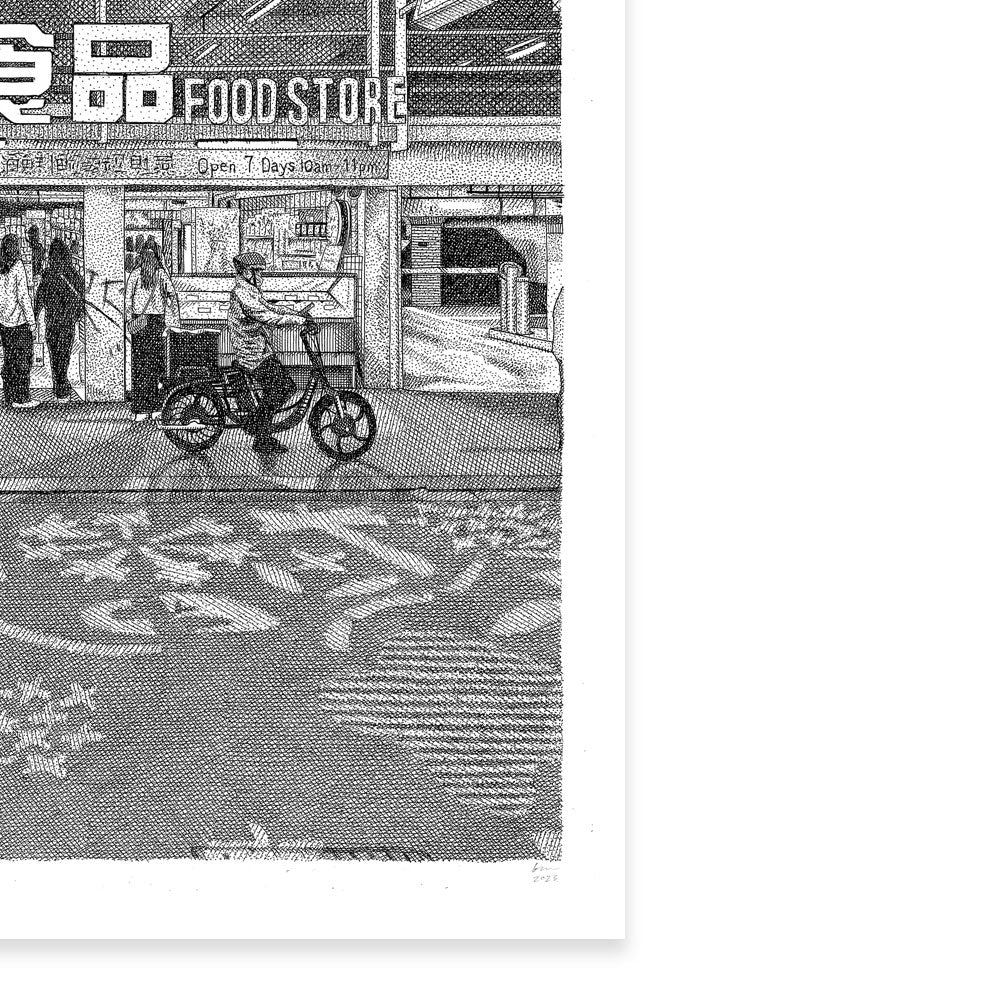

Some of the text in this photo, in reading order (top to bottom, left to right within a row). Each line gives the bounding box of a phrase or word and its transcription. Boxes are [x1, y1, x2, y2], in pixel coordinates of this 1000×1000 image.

[184, 76, 407, 125] FOOD STORE
[198, 157, 236, 178] Open
[244, 155, 254, 173] 7
[262, 157, 295, 176] Days
